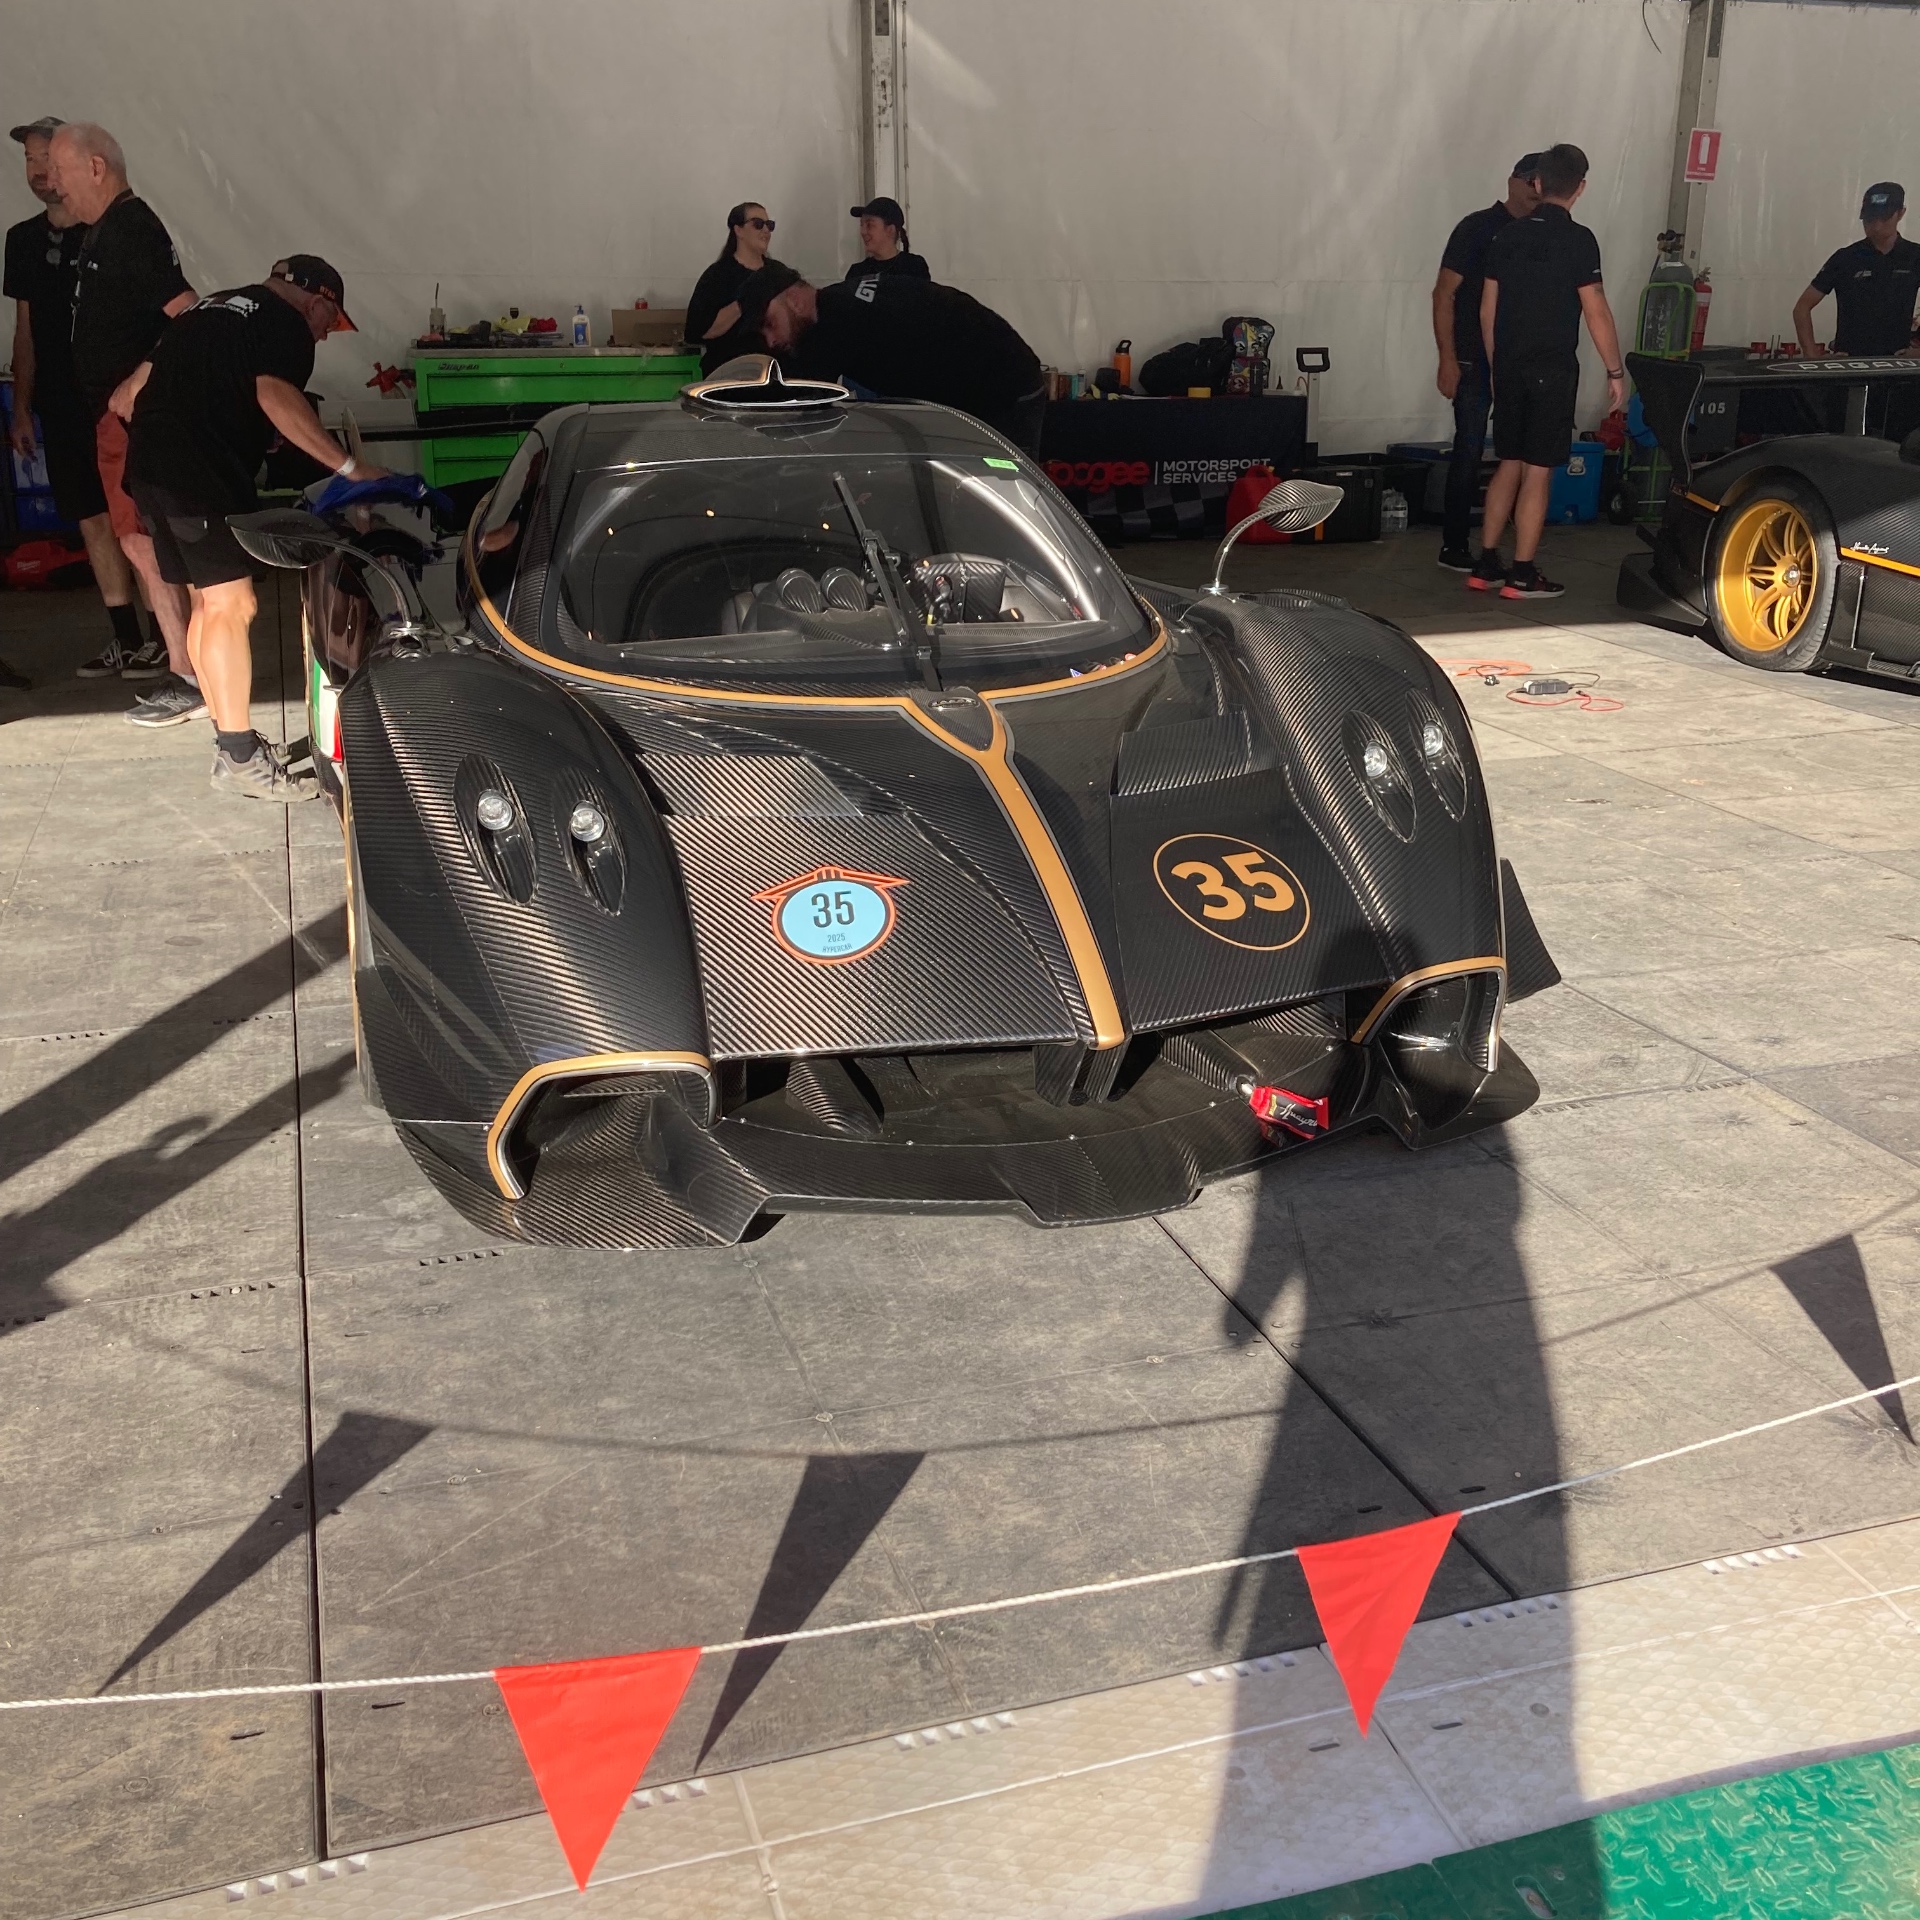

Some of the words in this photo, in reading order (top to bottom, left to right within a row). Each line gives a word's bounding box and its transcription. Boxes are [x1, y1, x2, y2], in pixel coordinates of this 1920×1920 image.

[1798, 360, 1918, 371] PAGAN
[1163, 458, 1271, 472] MOTORSPORT
[1163, 471, 1237, 484] SERVICES
[1170, 851, 1295, 921] 35
[811, 890, 855, 928] 35
[827, 933, 846, 943] 2025
[822, 943, 853, 953] HYPERCAR
